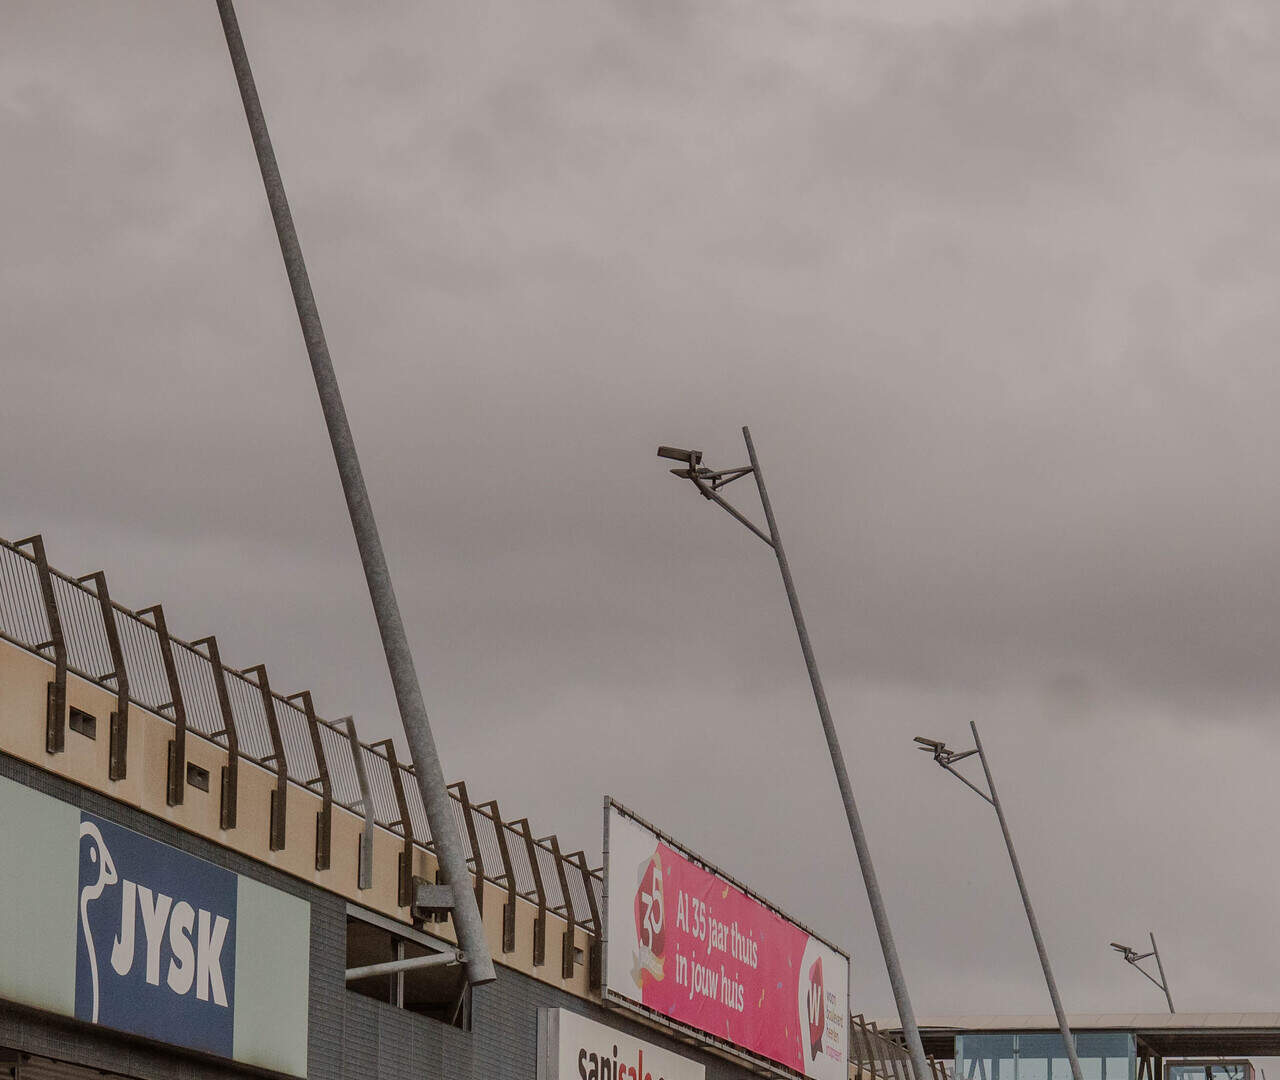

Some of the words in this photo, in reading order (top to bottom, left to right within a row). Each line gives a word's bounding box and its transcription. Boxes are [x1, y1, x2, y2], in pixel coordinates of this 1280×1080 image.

[110, 878, 230, 1008] JYSK
[676, 890, 690, 933] Al
[692, 896, 706, 942] 35
[707, 907, 729, 956] jaar
[731, 922, 759, 970] thuis
[675, 943, 688, 985] in
[689, 950, 719, 1001] jouw
[720, 965, 745, 1014] huis
